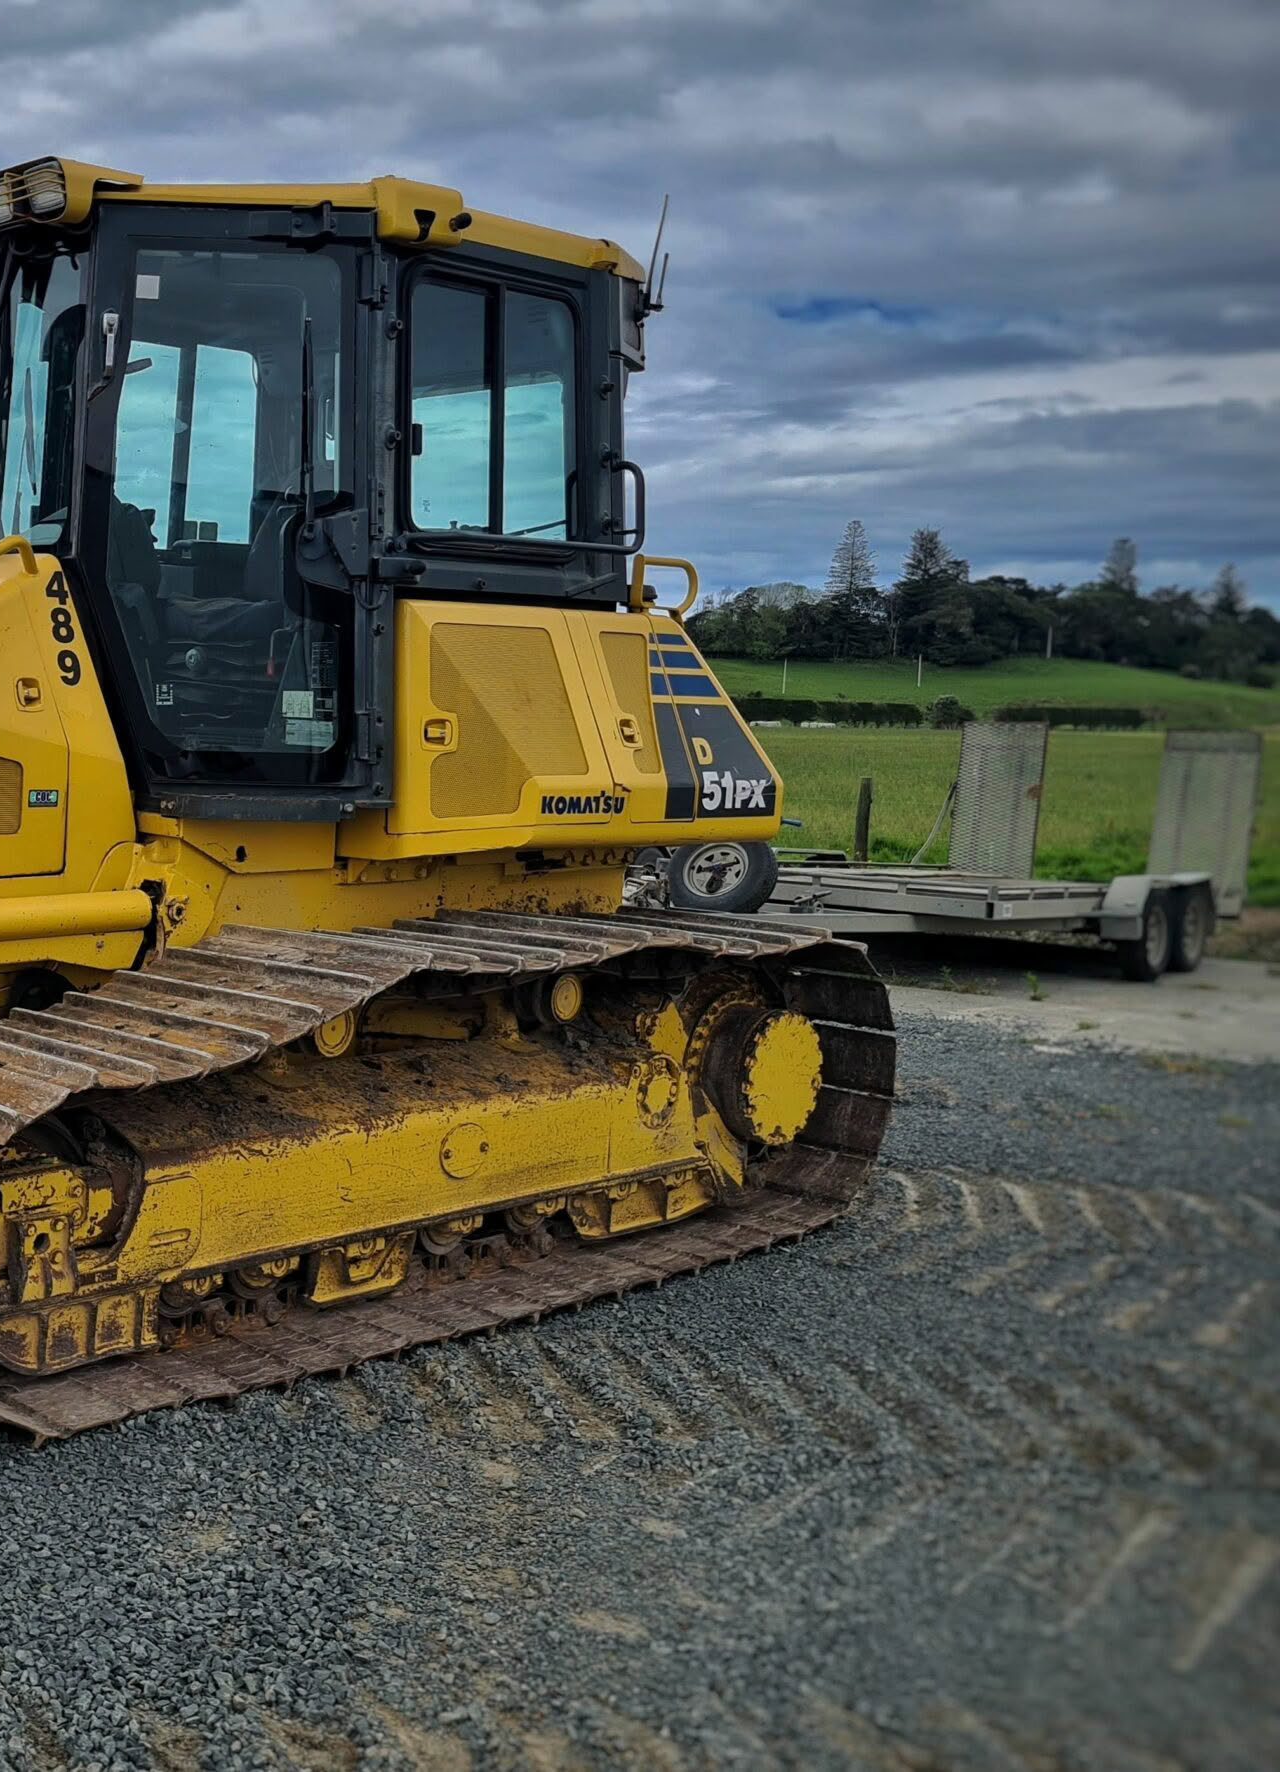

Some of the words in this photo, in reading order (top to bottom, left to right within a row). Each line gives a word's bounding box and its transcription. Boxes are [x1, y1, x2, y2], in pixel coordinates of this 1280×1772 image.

[45, 570, 81, 686] 489
[691, 737, 713, 765] D
[541, 790, 625, 815] KOMATSU
[701, 771, 767, 811] 51PX
